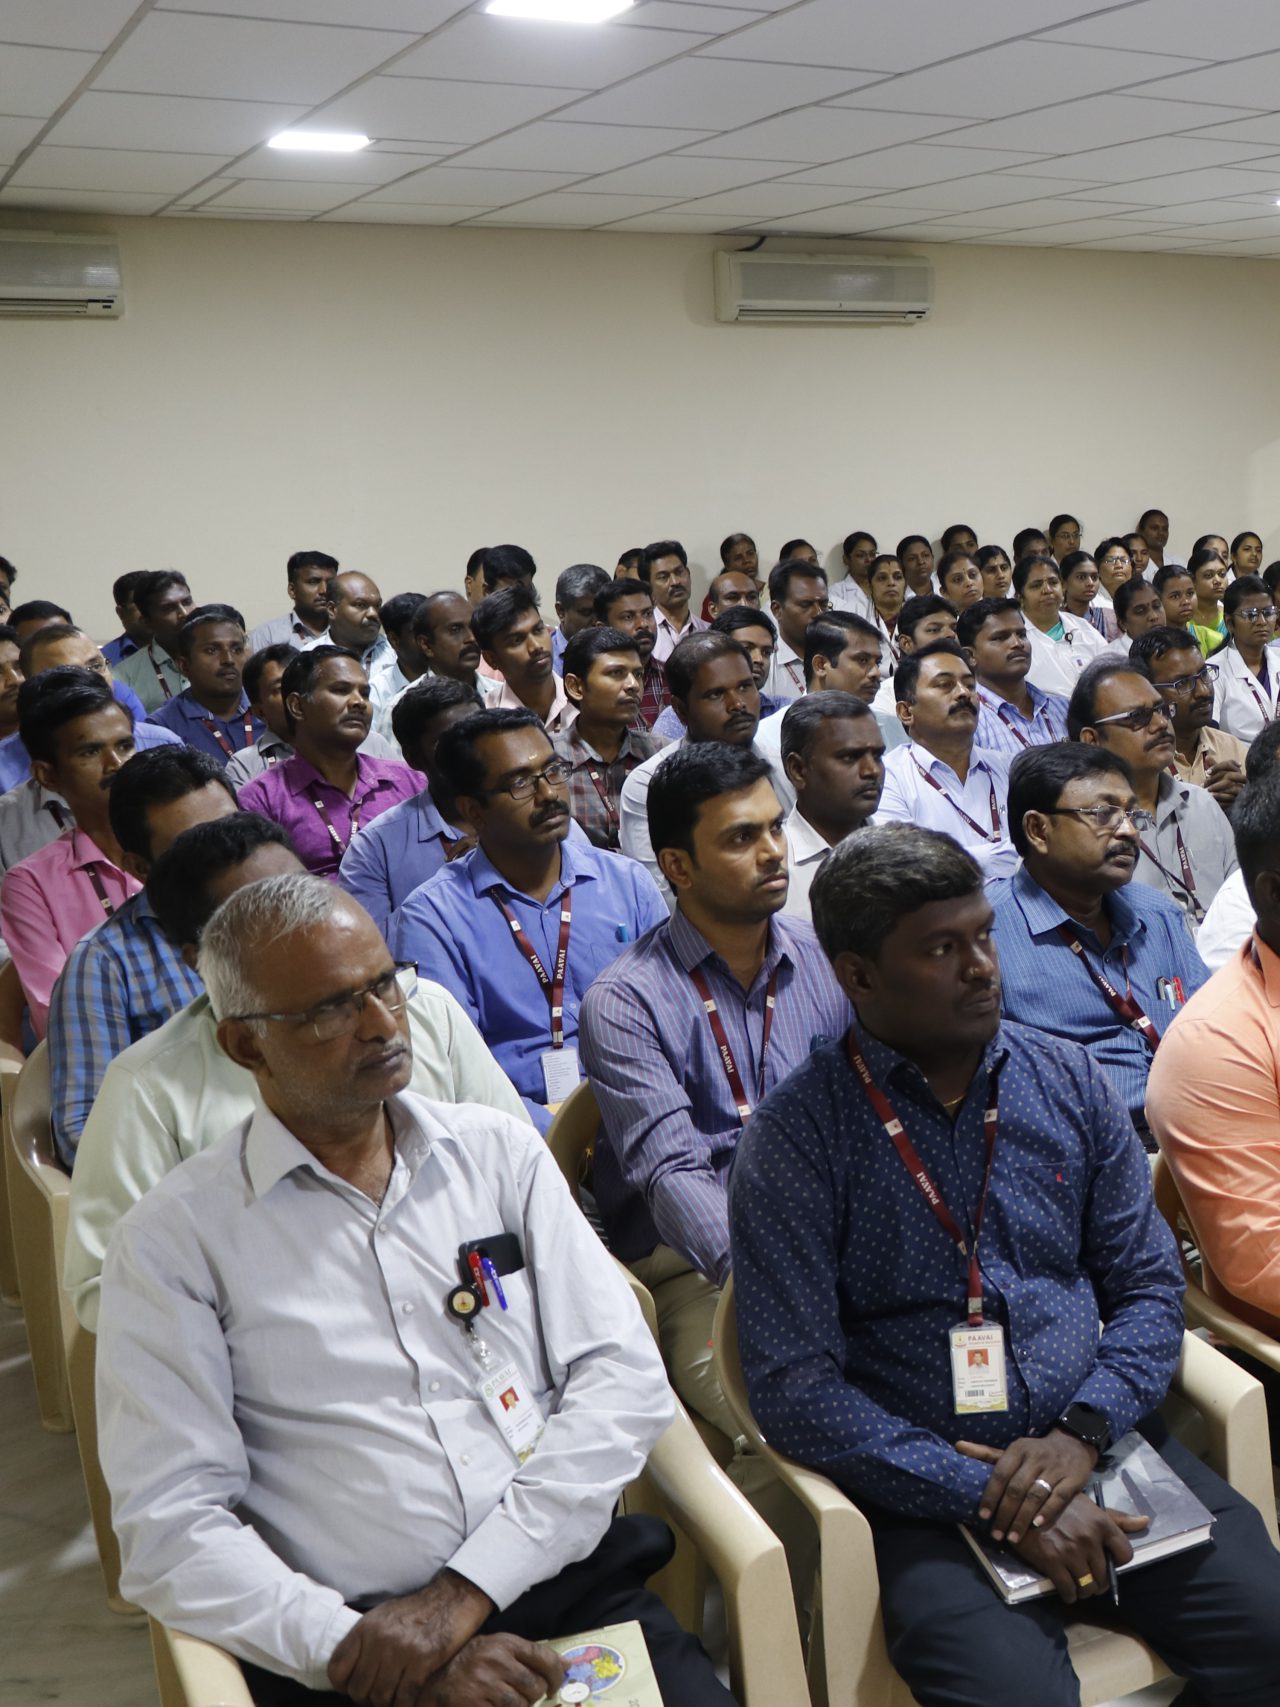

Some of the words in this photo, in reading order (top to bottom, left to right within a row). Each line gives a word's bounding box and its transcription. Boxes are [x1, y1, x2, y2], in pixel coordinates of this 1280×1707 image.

[1179, 846, 1189, 870] PAAVAI
[530, 954, 549, 984] PAAVAI
[556, 949, 566, 980] PAAVAI
[720, 1044, 735, 1073] PAAVAI
[853, 1055, 872, 1084] PAAVAI
[916, 1171, 940, 1206] PAAVAI
[968, 1334, 993, 1342] PAAVAI
